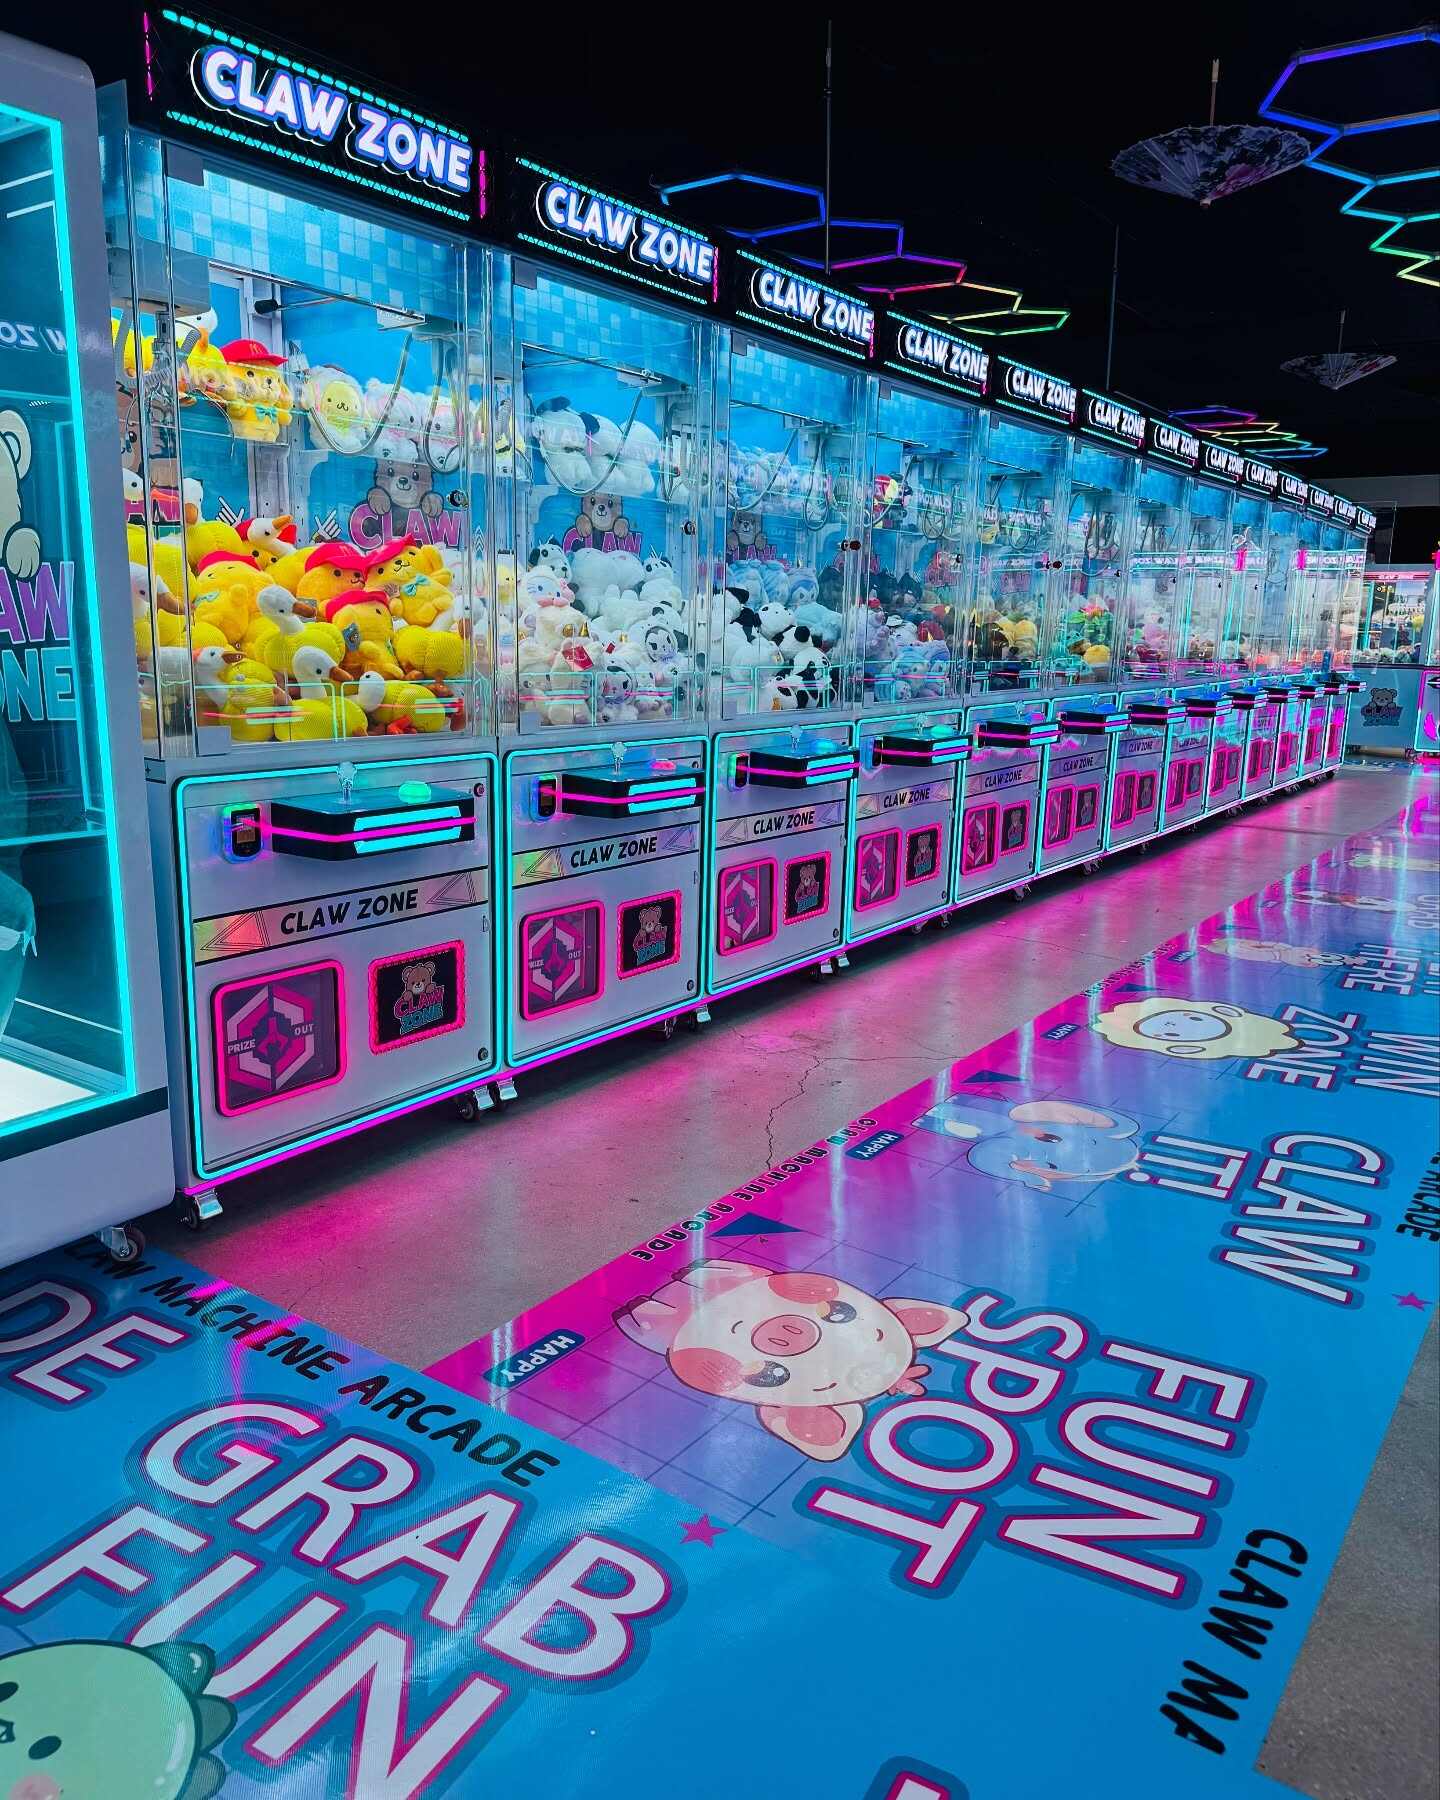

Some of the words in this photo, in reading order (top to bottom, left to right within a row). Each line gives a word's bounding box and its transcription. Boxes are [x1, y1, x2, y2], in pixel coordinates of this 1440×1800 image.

[203, 48, 344, 139] CLAW
[355, 109, 470, 190] ZONE
[546, 182, 634, 249] CLAW
[640, 220, 715, 281] ZONE
[758, 272, 820, 318] CLAW
[822, 293, 874, 340] ZONE
[904, 327, 948, 362] CLAW
[950, 343, 989, 381] ZONE
[1012, 369, 1044, 401] CLAW
[1046, 380, 1077, 411] ZONE
[1095, 400, 1120, 426] CLAW
[1121, 412, 1146, 439] ZONE
[1160, 427, 1180, 451] CLAW
[1180, 437, 1200, 459] ZONE
[1211, 448, 1228, 470] CLAW
[1228, 455, 1244, 477] ZONE
[349, 503, 466, 551] CLAW
[984, 775, 1003, 788] CLAW
[1004, 770, 1022, 783] ZONE
[1063, 760, 1079, 772] CLAW
[1079, 756, 1094, 769] ZONE
[753, 816, 784, 835] CLAW
[785, 811, 815, 830] ZONE
[883, 793, 908, 808] CLAW
[909, 788, 931, 804] ZONE
[570, 844, 615, 868] CLAW
[618, 836, 657, 859] ZONE
[281, 907, 353, 935] CLAW
[356, 889, 419, 920] ZONE
[1341, 943, 1422, 996] HERE
[394, 985, 445, 1019] CLAW
[400, 1003, 444, 1035] ZONE
[227, 1038, 256, 1053] PRIZE
[294, 1023, 314, 1036] OUT
[1246, 1004, 1361, 1092] ZONE
[856, 1133, 899, 1158] HAPPY
[1128, 1134, 1250, 1200] IT!
[733, 1146, 831, 1202] MACHINE
[629, 1202, 734, 1261] ARCADE
[1219, 1133, 1386, 1304] CLAW
[139, 1276, 355, 1382] MACHINE
[337, 1375, 561, 1487] ARCADE
[500, 1335, 576, 1383] HAPPY
[808, 1291, 1090, 1588] SPOT
[1000, 1339, 1256, 1600] FUN
[143, 1401, 673, 1684] GRAB
[1202, 1529, 1309, 1660] CLAW
[0, 1504, 510, 1800] FUN
[1158, 1659, 1250, 1756] MA
